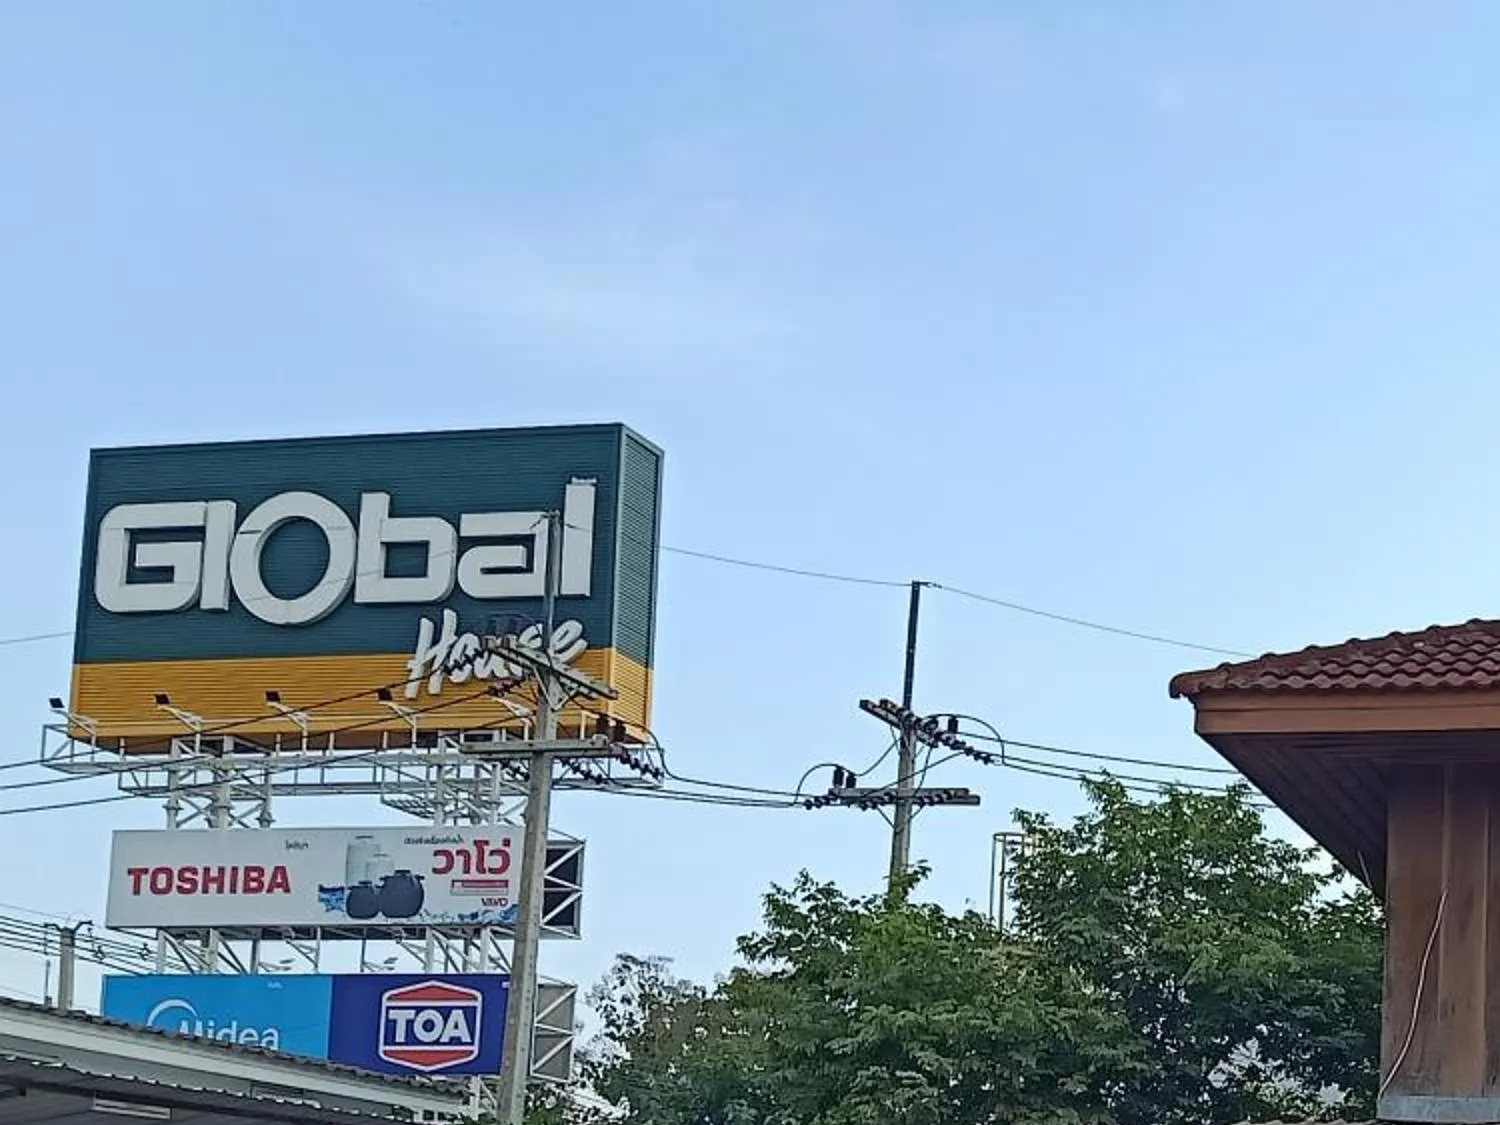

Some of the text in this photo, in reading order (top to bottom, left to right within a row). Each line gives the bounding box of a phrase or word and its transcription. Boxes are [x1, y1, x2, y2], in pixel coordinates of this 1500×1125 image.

[404, 608, 588, 698] House
[432, 838, 512, 875] วาโว่
[127, 866, 292, 896] TOSHIBA
[388, 1008, 473, 1045] TOA
